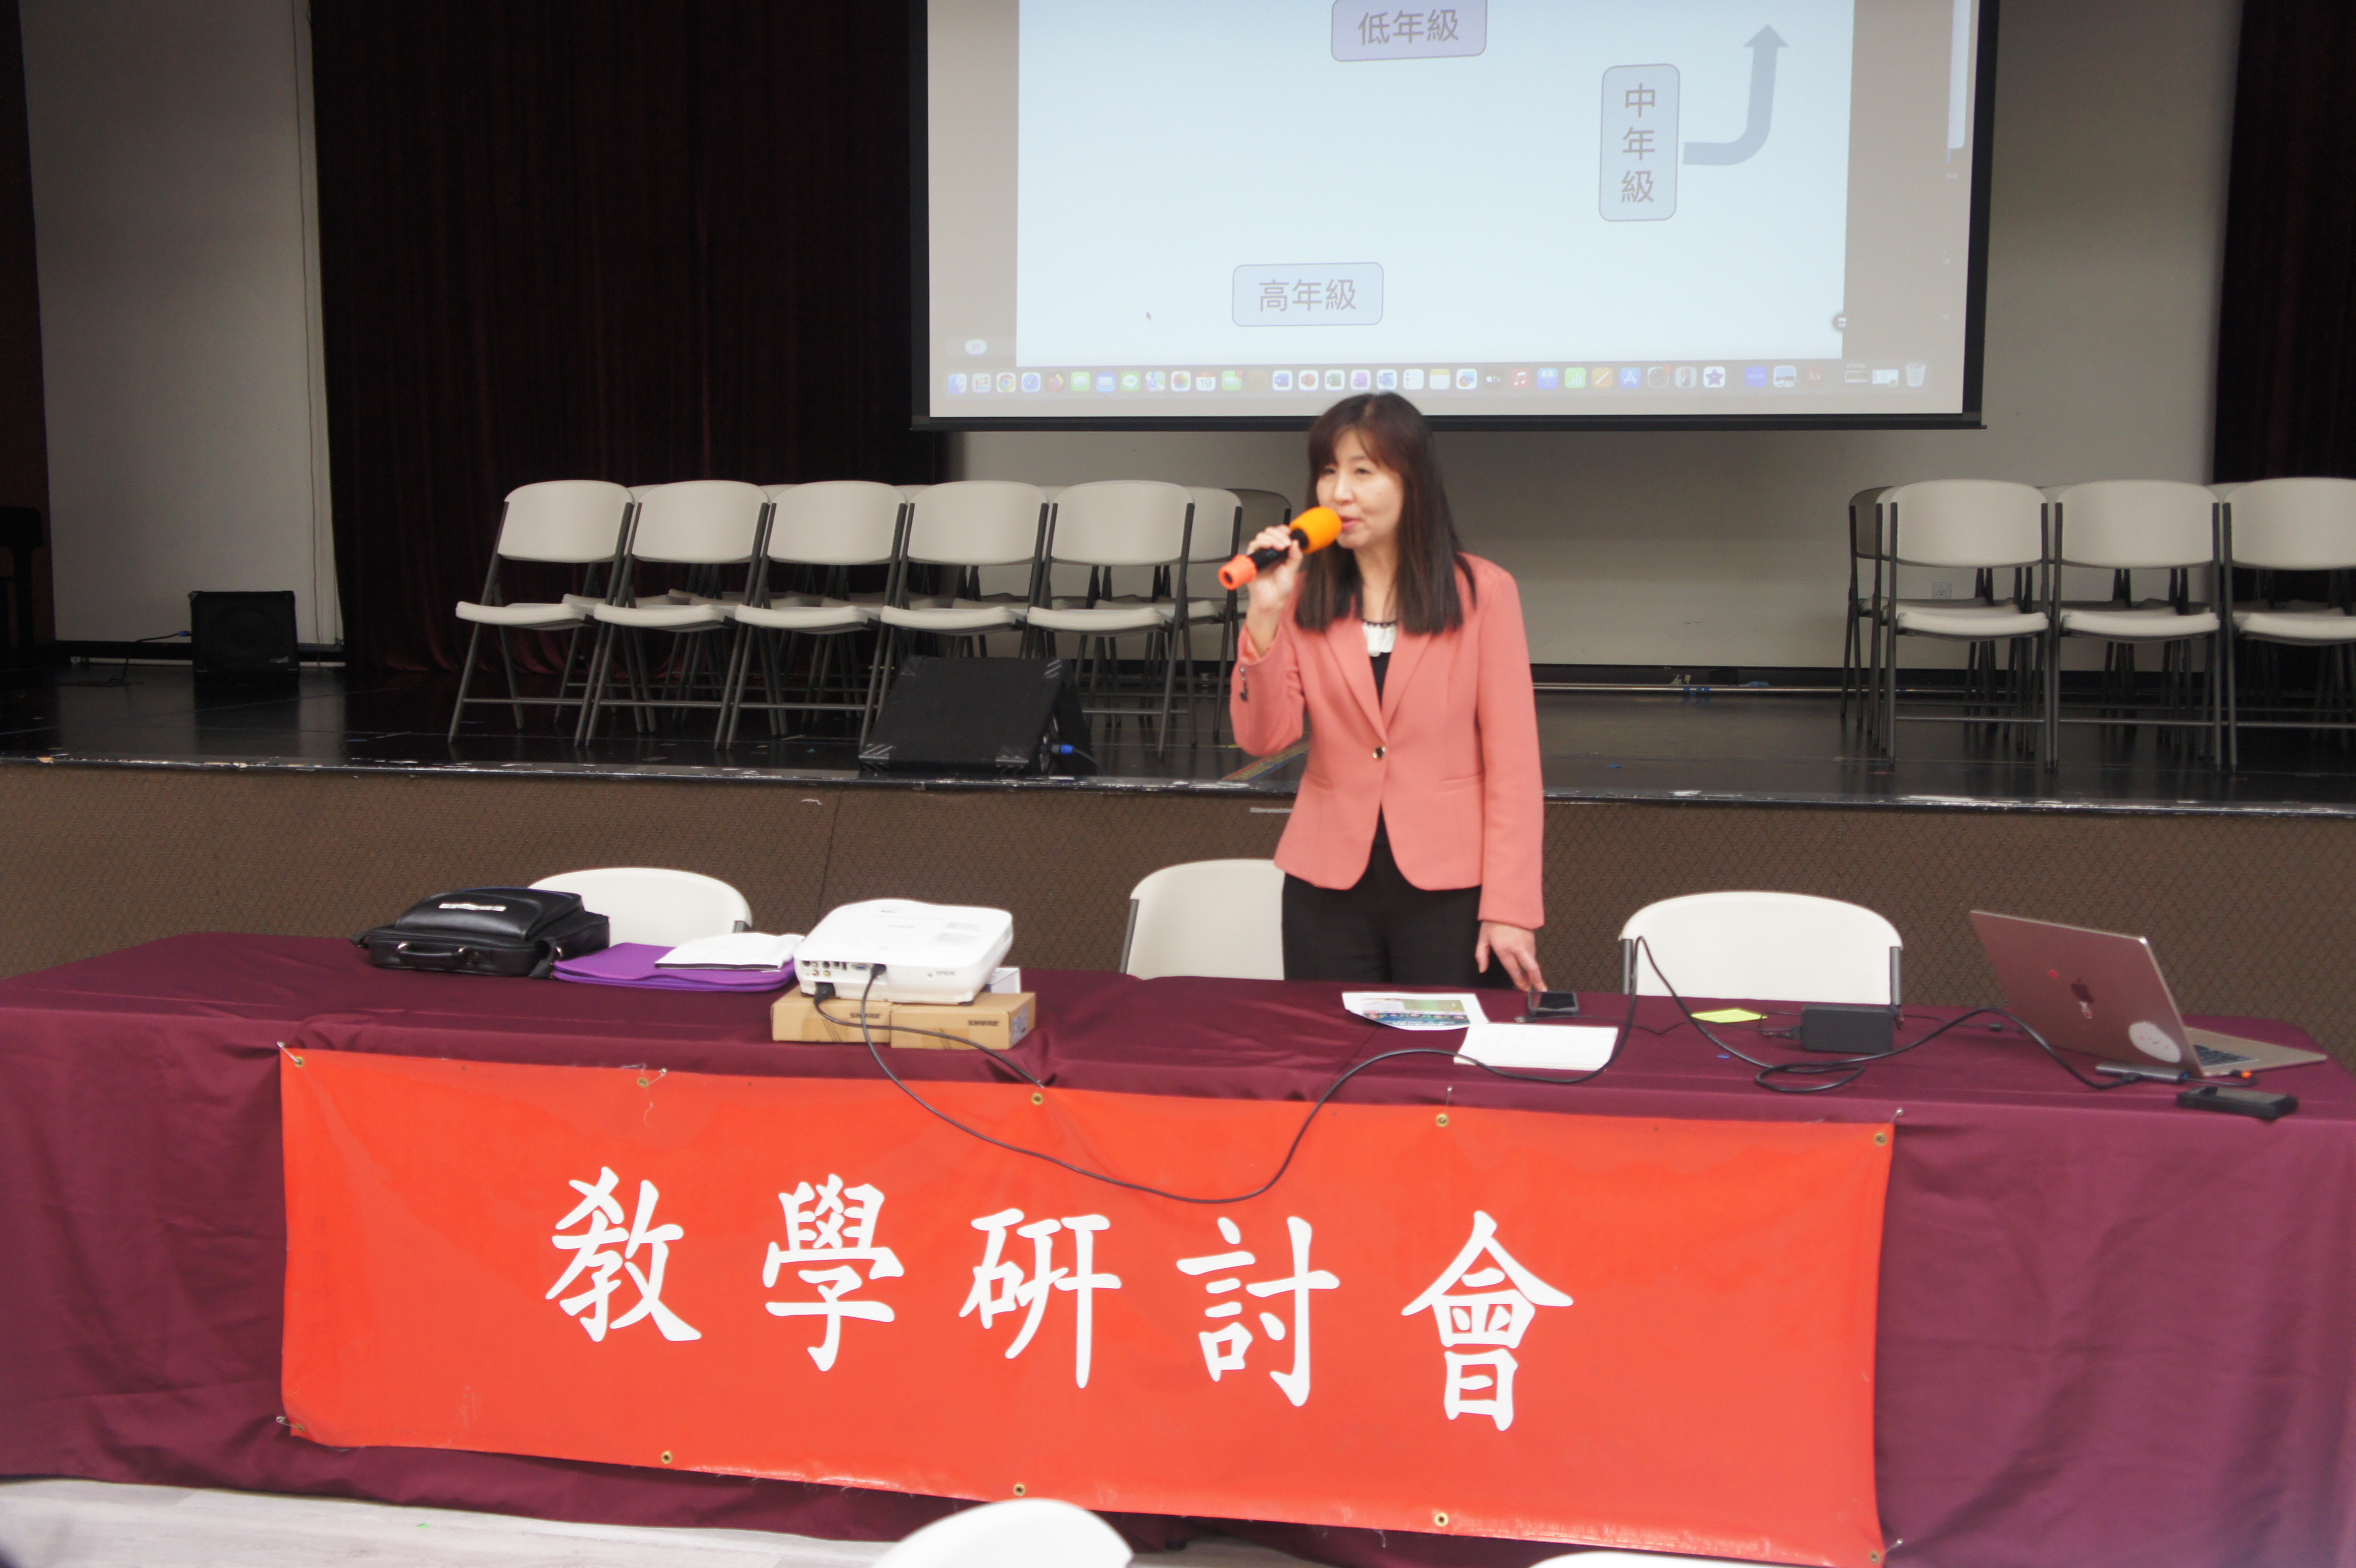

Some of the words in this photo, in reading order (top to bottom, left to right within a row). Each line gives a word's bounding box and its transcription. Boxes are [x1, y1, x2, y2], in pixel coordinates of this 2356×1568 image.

[1358, 9, 1459, 46] 低年級
[1620, 83, 1657, 204] 中年級
[1258, 279, 1357, 313] 高年級
[1199, 378, 1212, 388] 19
